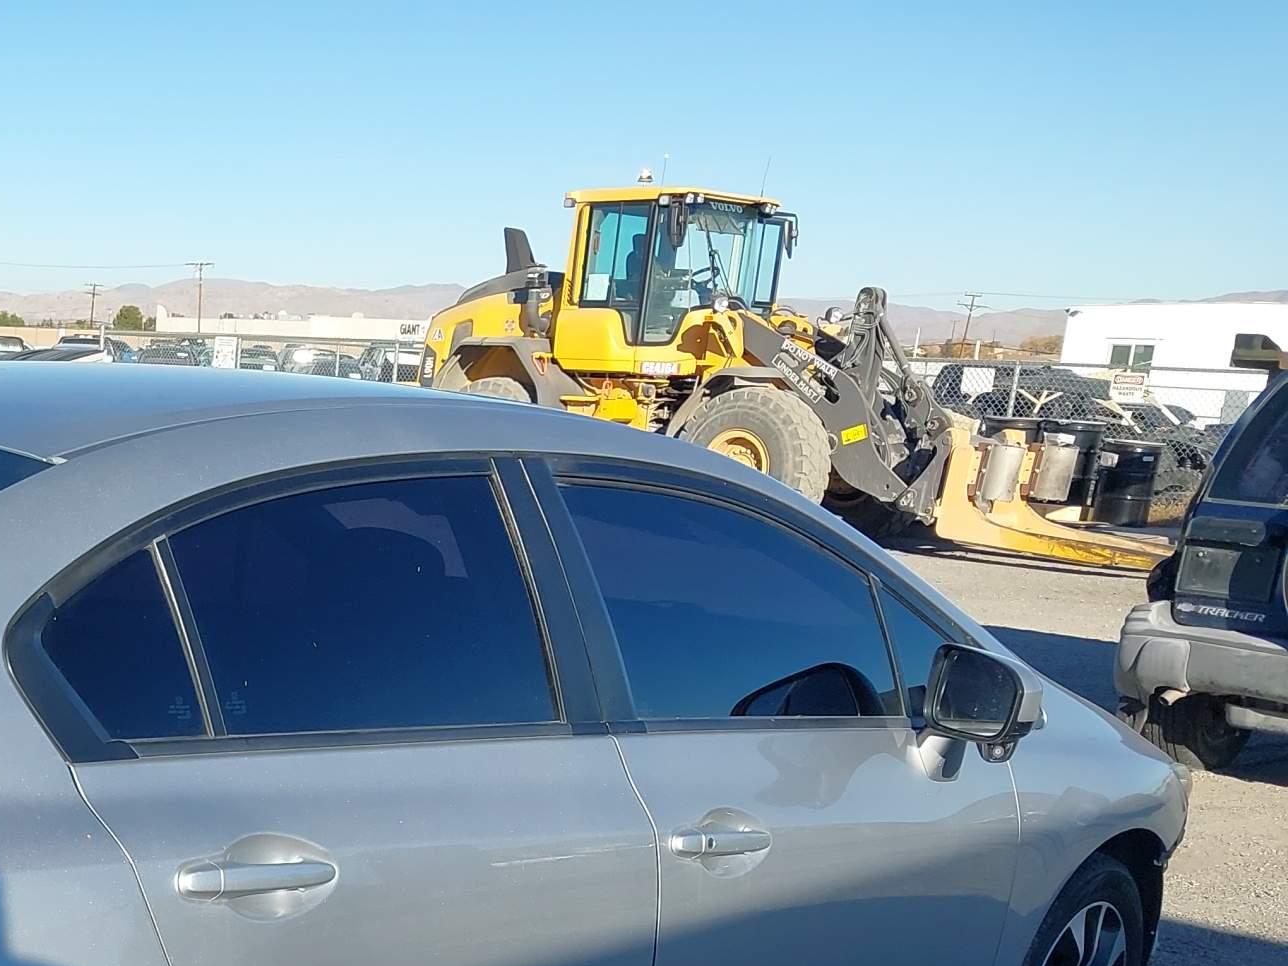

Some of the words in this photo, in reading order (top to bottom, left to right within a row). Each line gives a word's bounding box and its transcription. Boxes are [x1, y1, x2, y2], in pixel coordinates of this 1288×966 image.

[710, 201, 743, 214] VOLVO
[400, 323, 420, 335] GIANT
[423, 356, 434, 378] L90H
[783, 342, 796, 354] DO
[796, 348, 813, 363] NOT
[813, 359, 836, 379] WALK
[777, 359, 800, 385] UNDER
[798, 379, 818, 399] MAST
[1198, 605, 1267, 622] TRACKER
